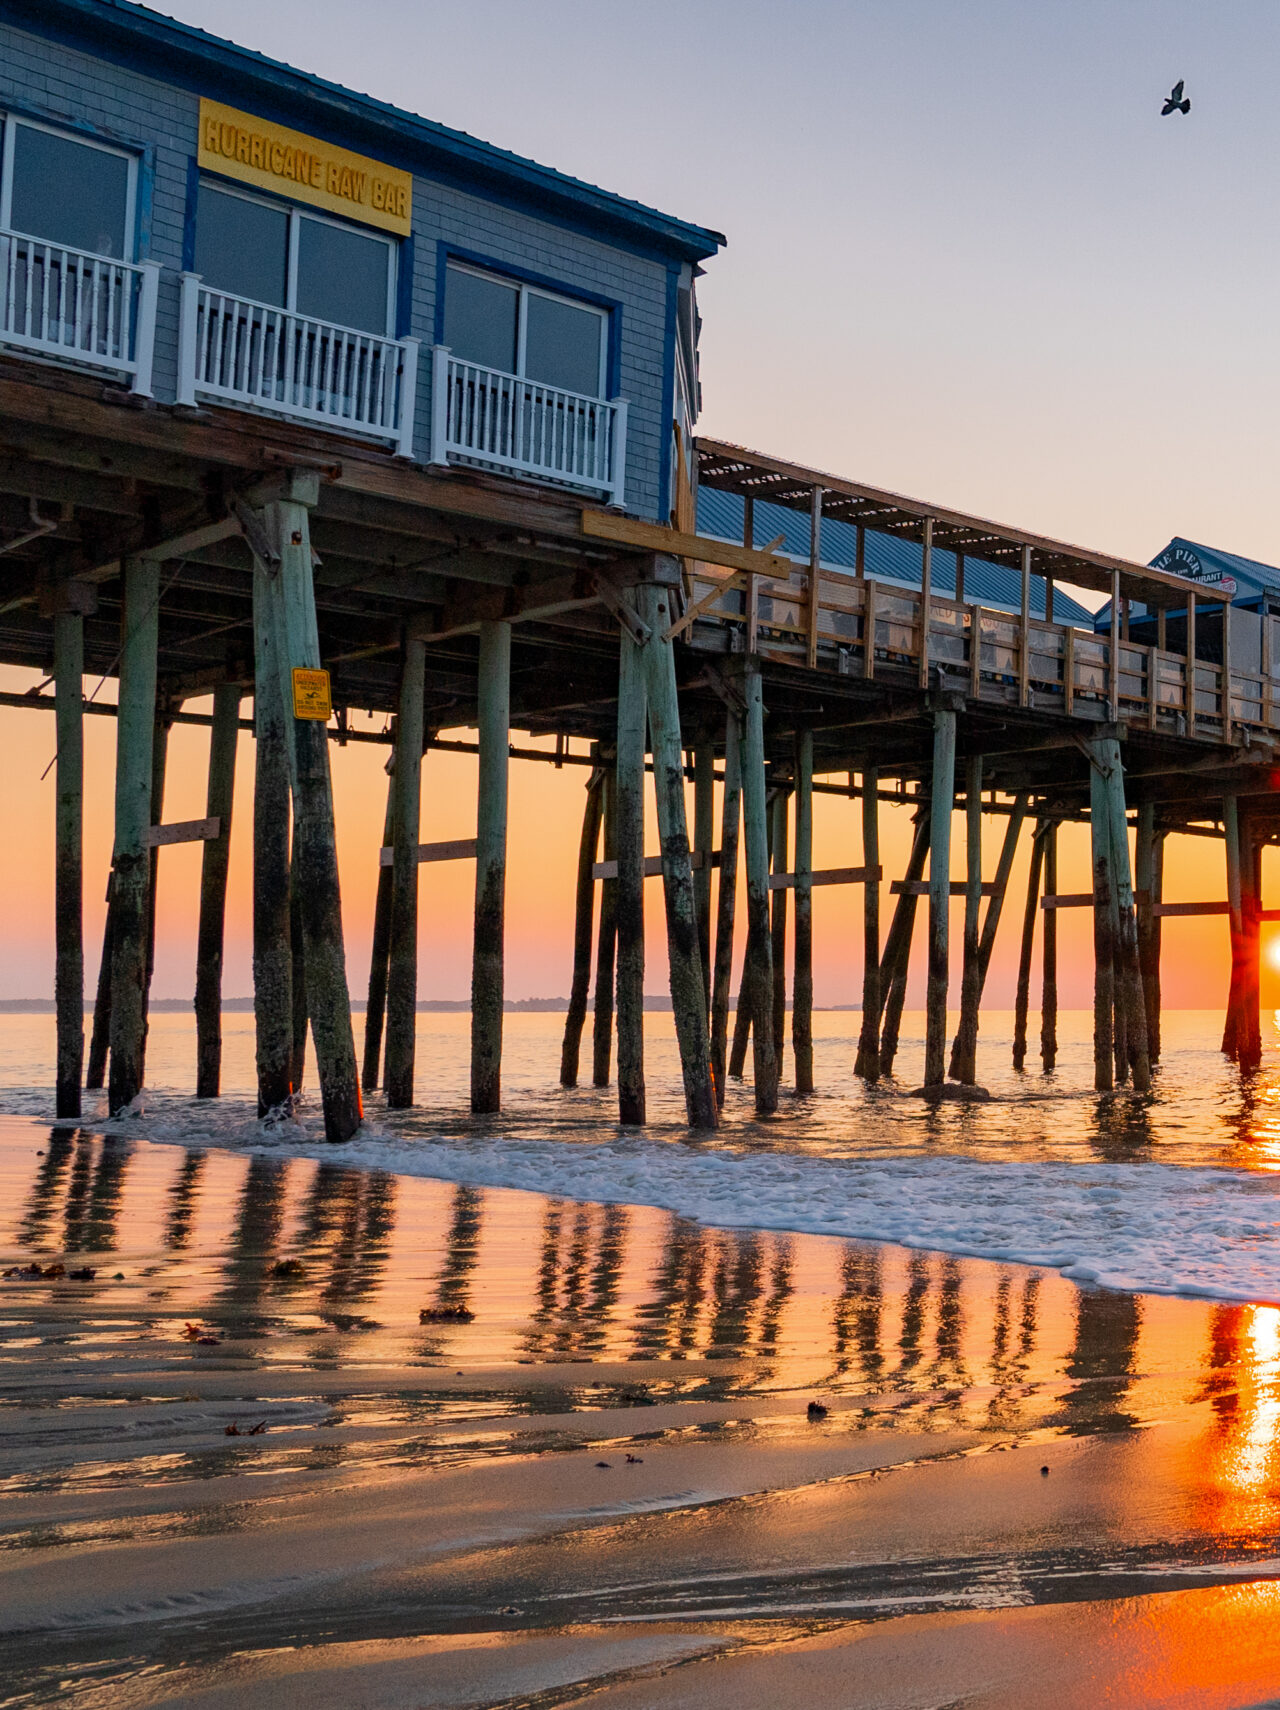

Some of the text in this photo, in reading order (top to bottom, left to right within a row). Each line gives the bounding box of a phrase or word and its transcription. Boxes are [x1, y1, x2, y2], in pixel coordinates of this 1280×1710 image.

[204, 117, 408, 219] HURRICANE RAW BAR
[1175, 549, 1200, 575] PIER
